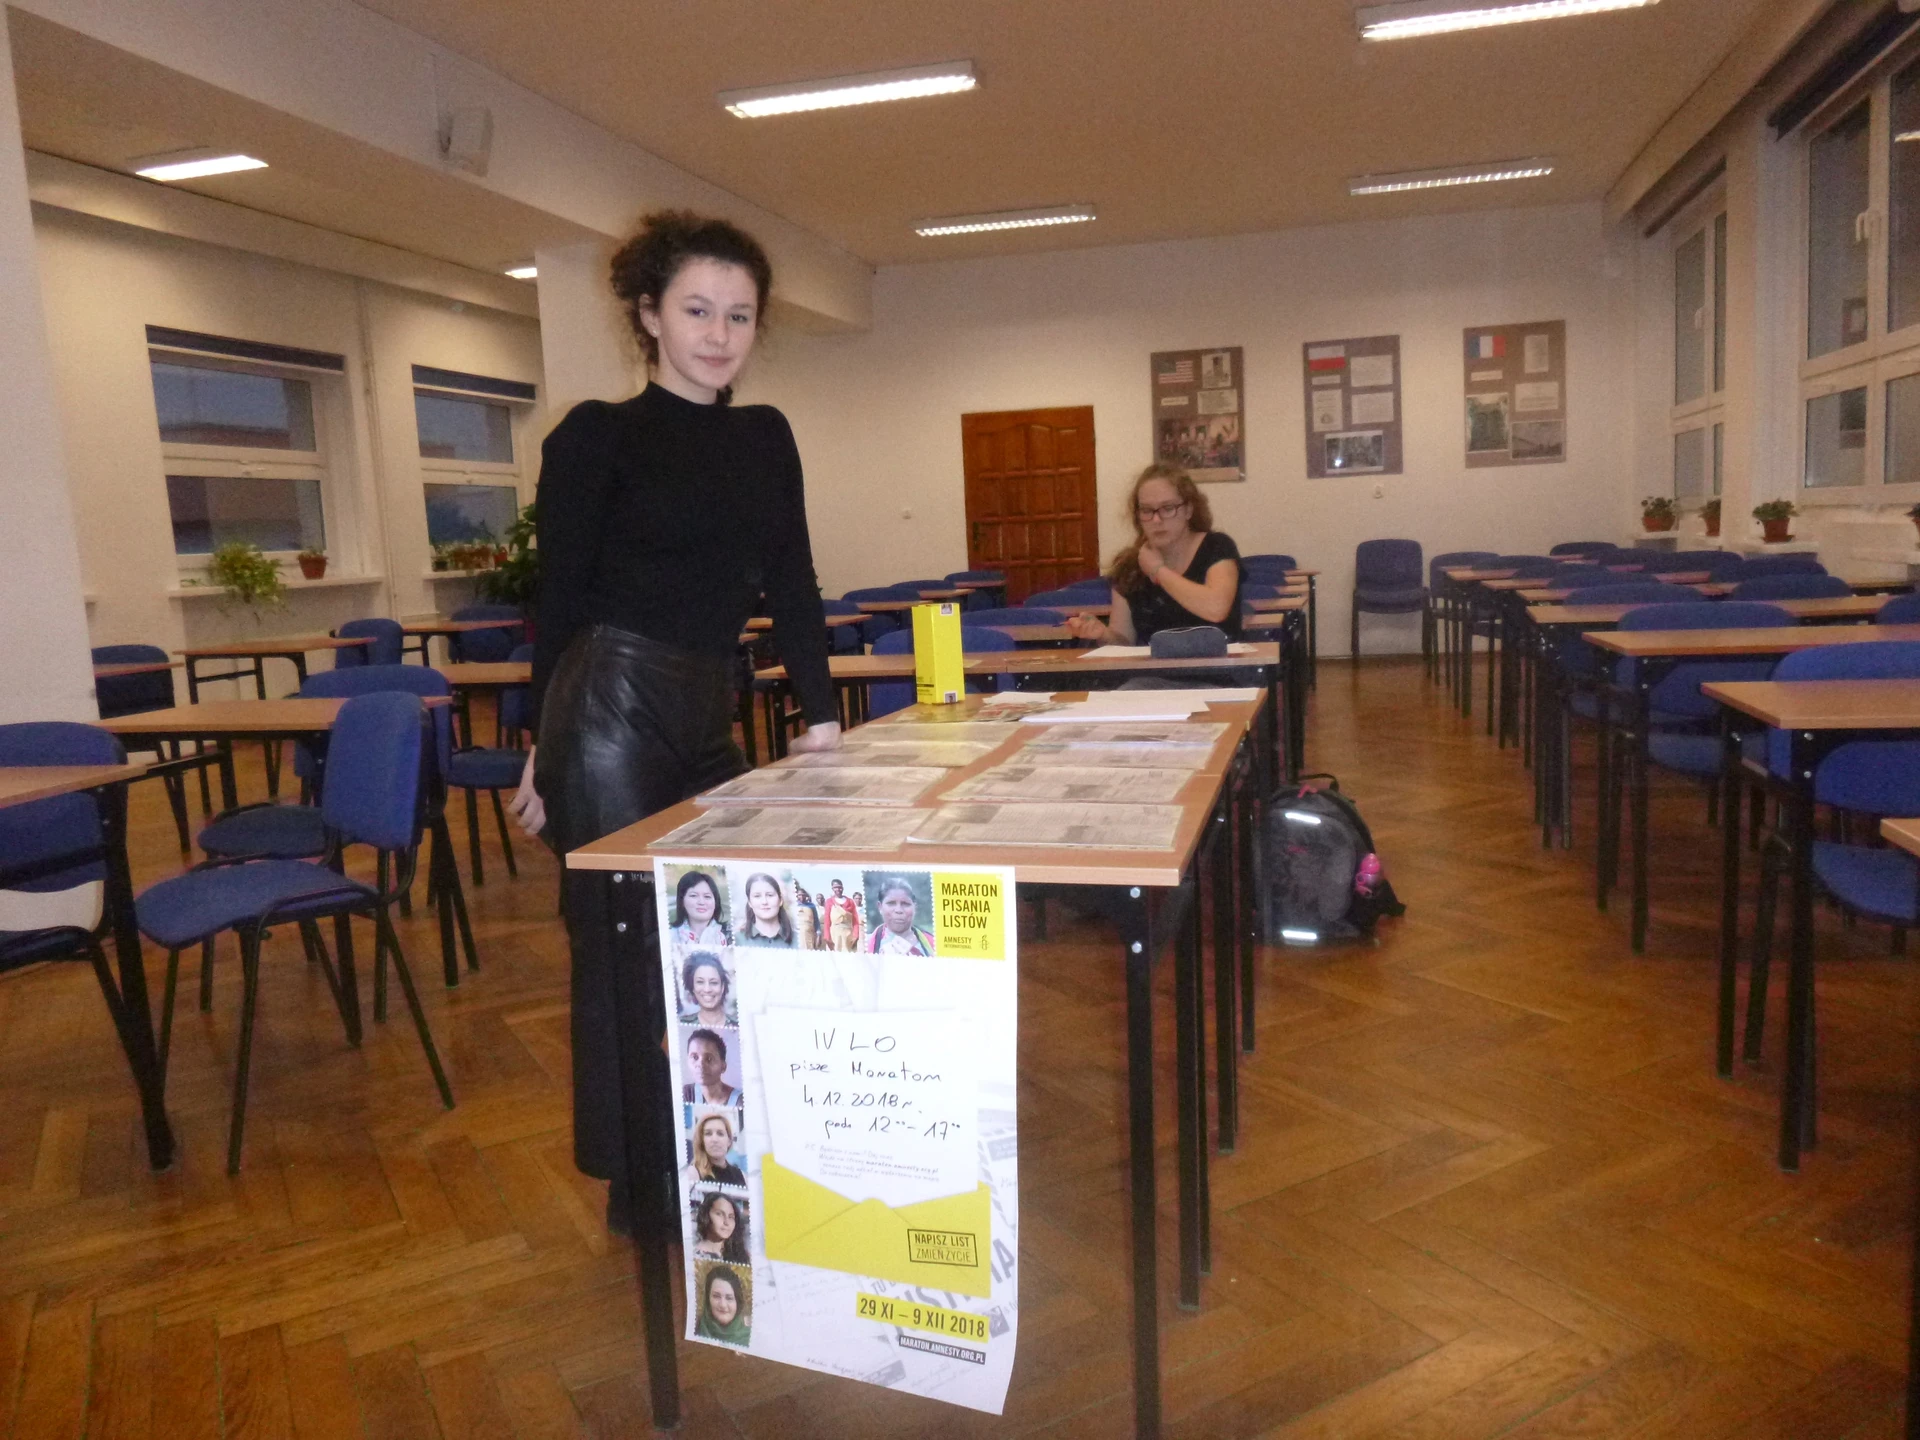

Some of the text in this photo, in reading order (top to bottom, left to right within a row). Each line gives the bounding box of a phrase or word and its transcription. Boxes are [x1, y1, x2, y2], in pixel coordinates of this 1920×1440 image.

[941, 883, 998, 897] MARATON
[942, 899, 991, 913] PISANIA
[943, 913, 987, 929] LISTÓW
[944, 936, 972, 944] AMNESTY
[814, 1028, 896, 1053] IV LO
[915, 1233, 970, 1247] NAPISZ LIST
[860, 1298, 876, 1316] 29
[881, 1302, 894, 1320] XI
[913, 1308, 921, 1325] 9
[926, 1310, 945, 1330] XII
[950, 1315, 985, 1338] 2018
[900, 1336, 984, 1363] MARATON.AMNESTY.ORG.PL
